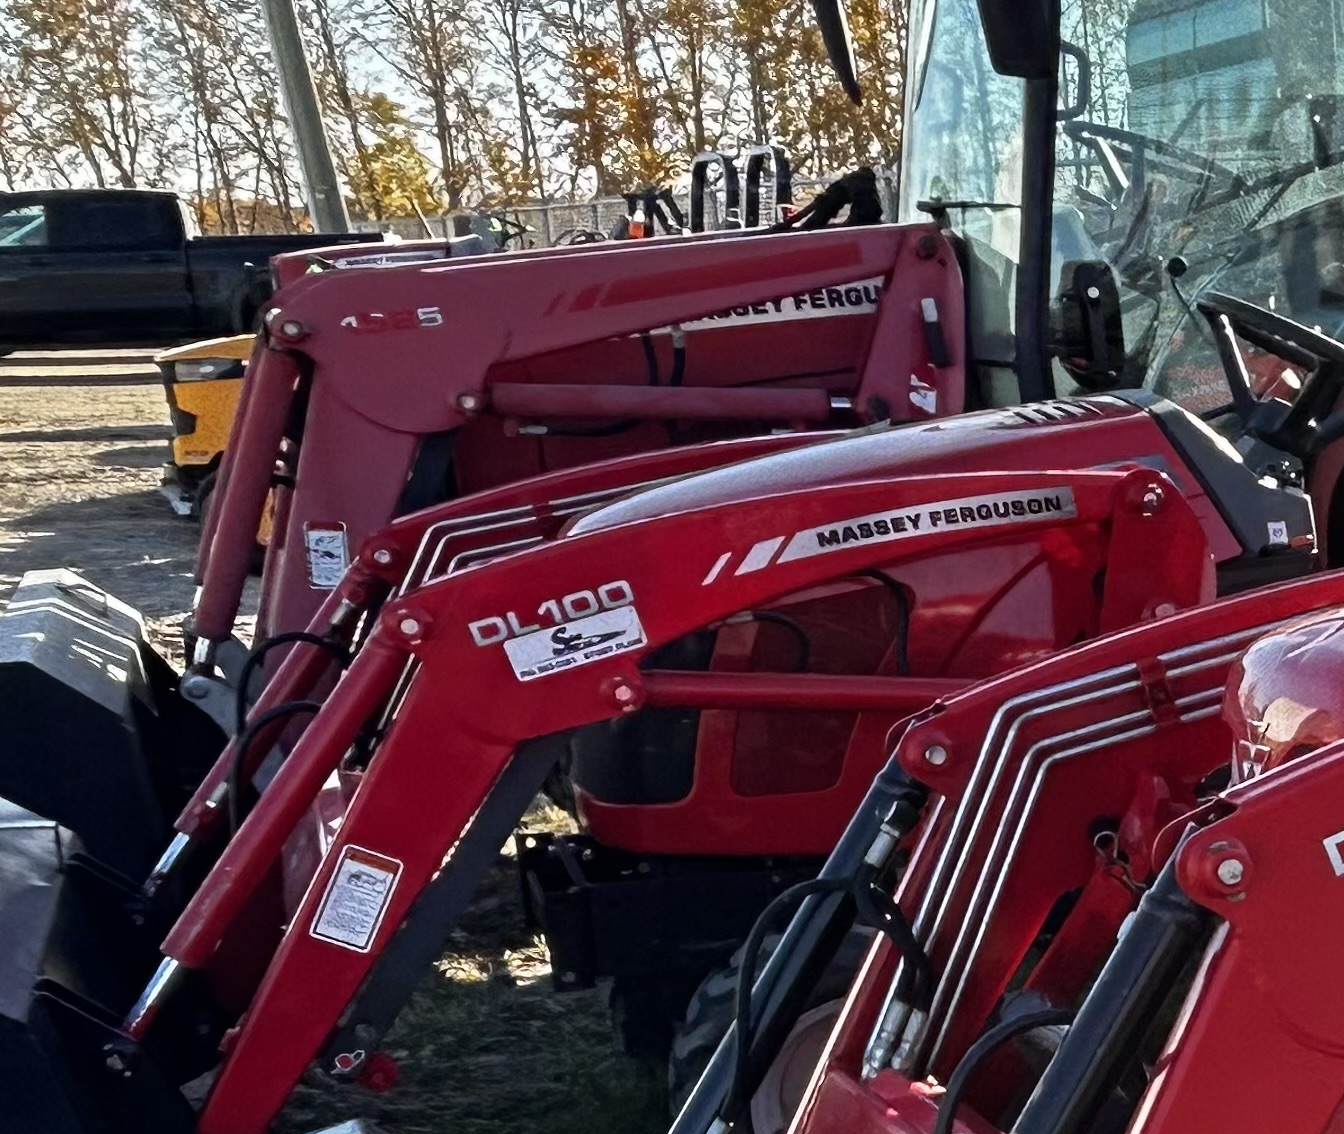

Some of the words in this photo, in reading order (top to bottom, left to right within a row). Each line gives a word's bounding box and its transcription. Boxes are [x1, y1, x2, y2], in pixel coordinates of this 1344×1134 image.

[816, 513, 921, 547] MASSEY
[929, 495, 1062, 528] FERGUSON
[467, 579, 635, 647] DL100
